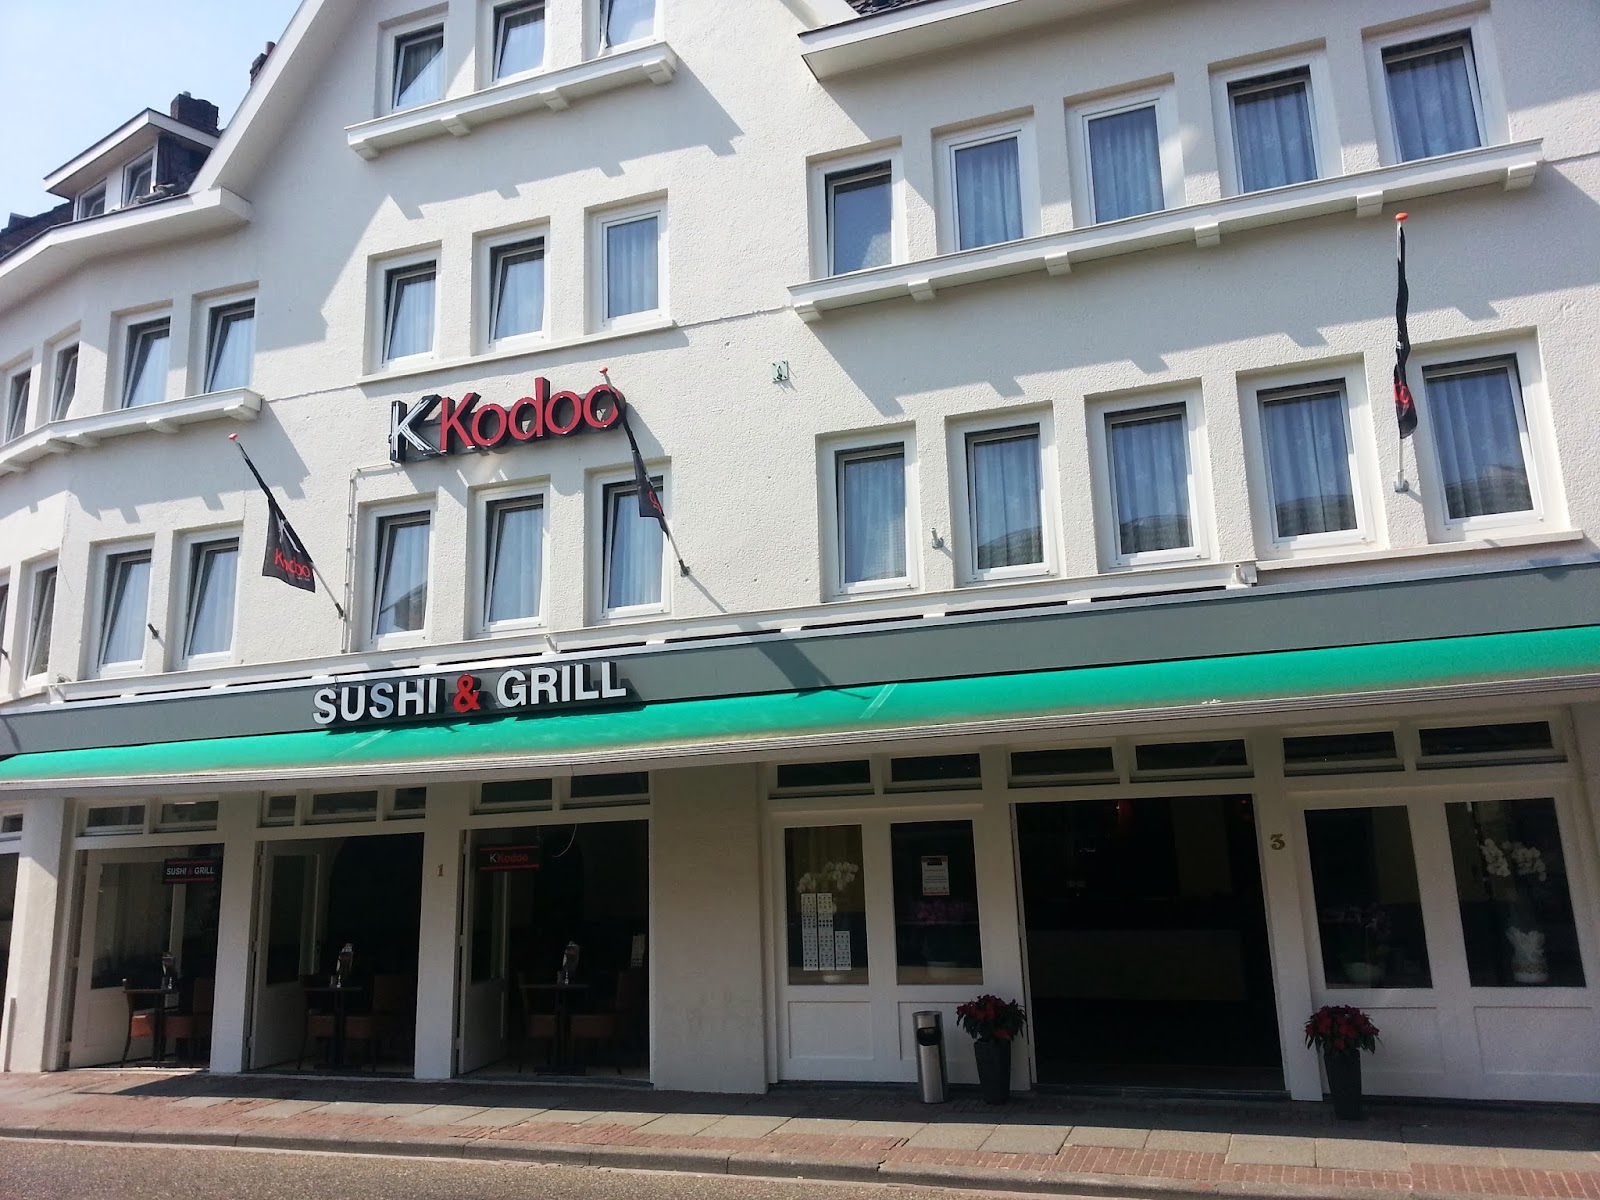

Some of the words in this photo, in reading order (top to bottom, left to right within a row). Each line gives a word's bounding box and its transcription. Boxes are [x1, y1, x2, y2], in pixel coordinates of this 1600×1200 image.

[440, 377, 623, 454] Kodoo
[313, 677, 441, 726] SUSHI
[453, 674, 481, 714] &
[497, 661, 627, 708] GRILL
[1270, 832, 1286, 850] 3
[166, 867, 187, 876] SUSHI
[194, 866, 215, 875] GRILL
[437, 864, 444, 877] 1
